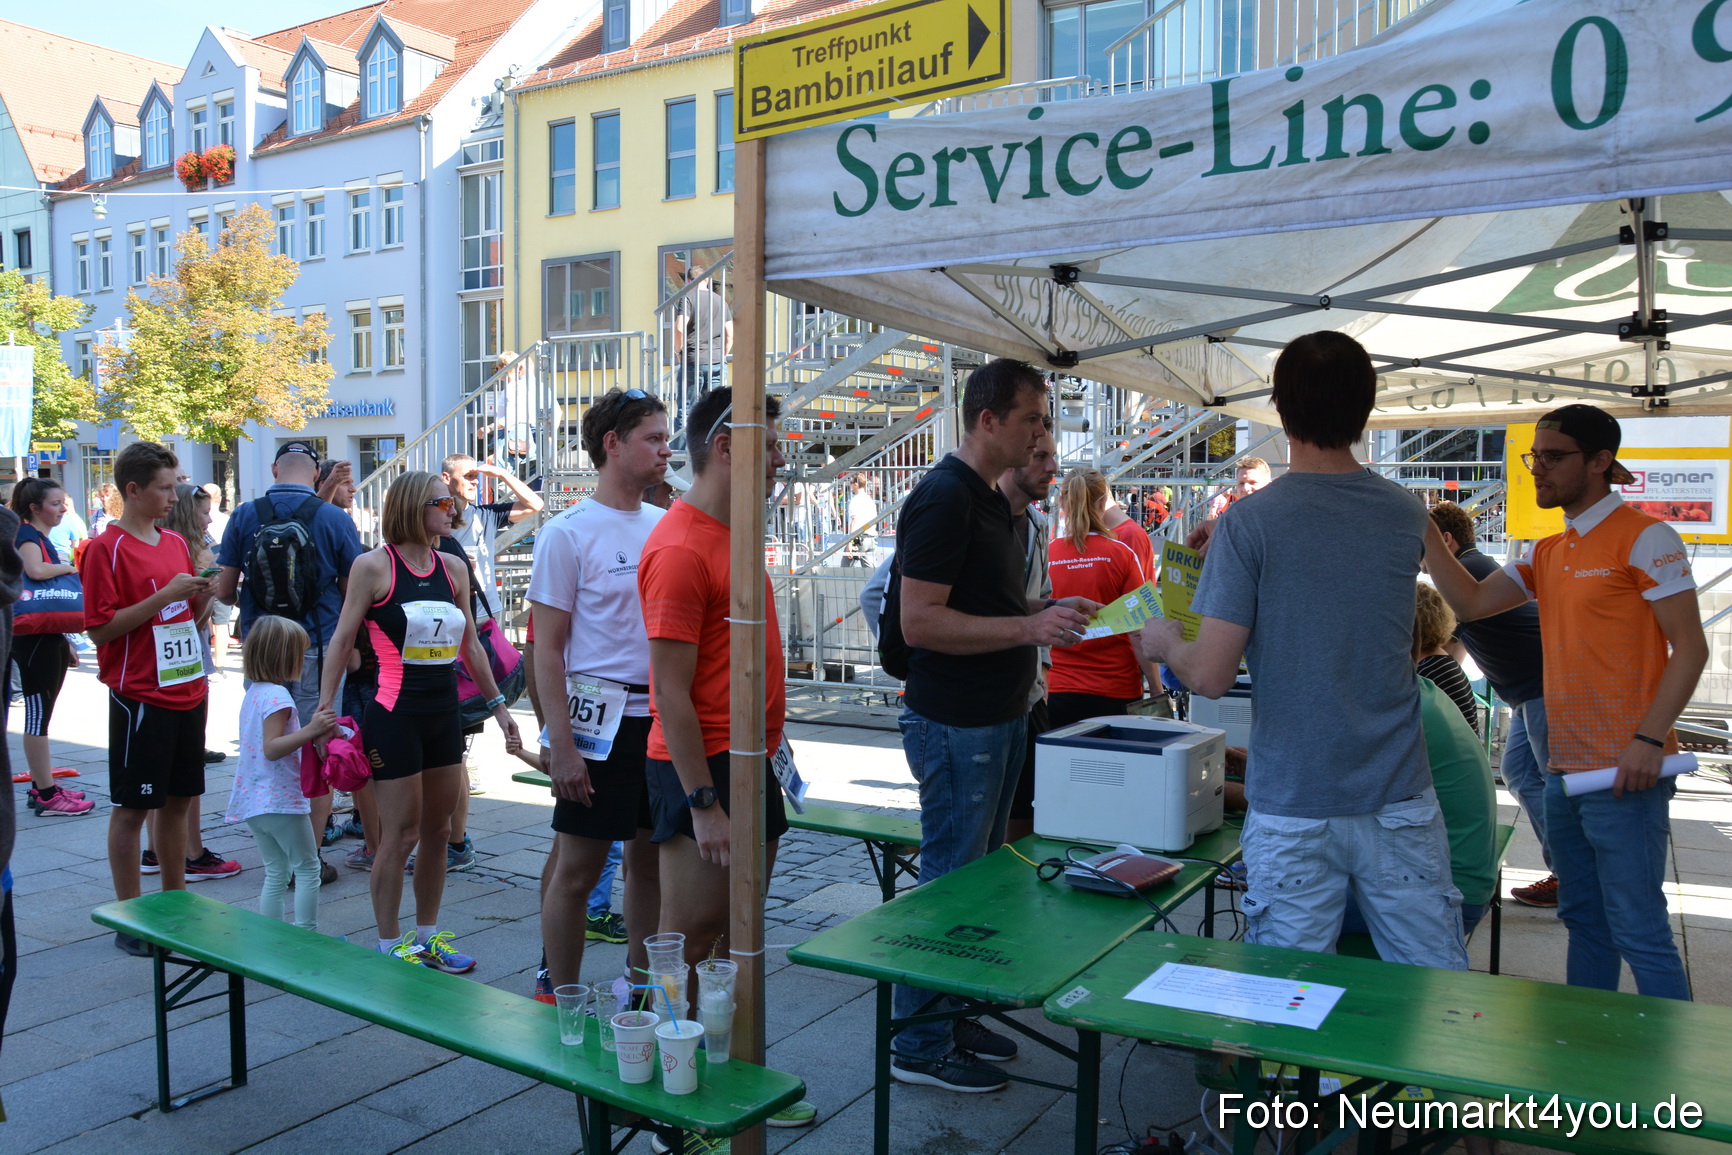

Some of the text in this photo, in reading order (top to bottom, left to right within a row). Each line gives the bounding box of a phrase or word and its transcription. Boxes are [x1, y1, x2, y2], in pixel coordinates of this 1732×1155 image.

[792, 20, 912, 68] Treffpunkt
[751, 41, 955, 117] Bambinilauf
[833, 66, 1492, 217] Service-Line:
[1551, 15, 1629, 131] 0
[29, 456, 36, 468] P
[1647, 472, 1714, 486] Egner
[1051, 557, 1111, 566] Sulzbach-Rosenberg
[1167, 548, 1204, 570] URKU
[1166, 566, 1185, 586] 19.
[1574, 567, 1611, 578] bibchip
[33, 588, 79, 600] Fidelity
[1186, 581, 1197, 590] Sta
[1124, 594, 1139, 612] 19.
[433, 618, 443, 637] 7
[430, 649, 442, 657] Eva
[567, 694, 607, 726] 051
[571, 725, 593, 734] eumarkt
[140, 783, 153, 795] 25
[871, 935, 1012, 966] Lammsbräu
[901, 934, 1005, 955] Neumarkter
